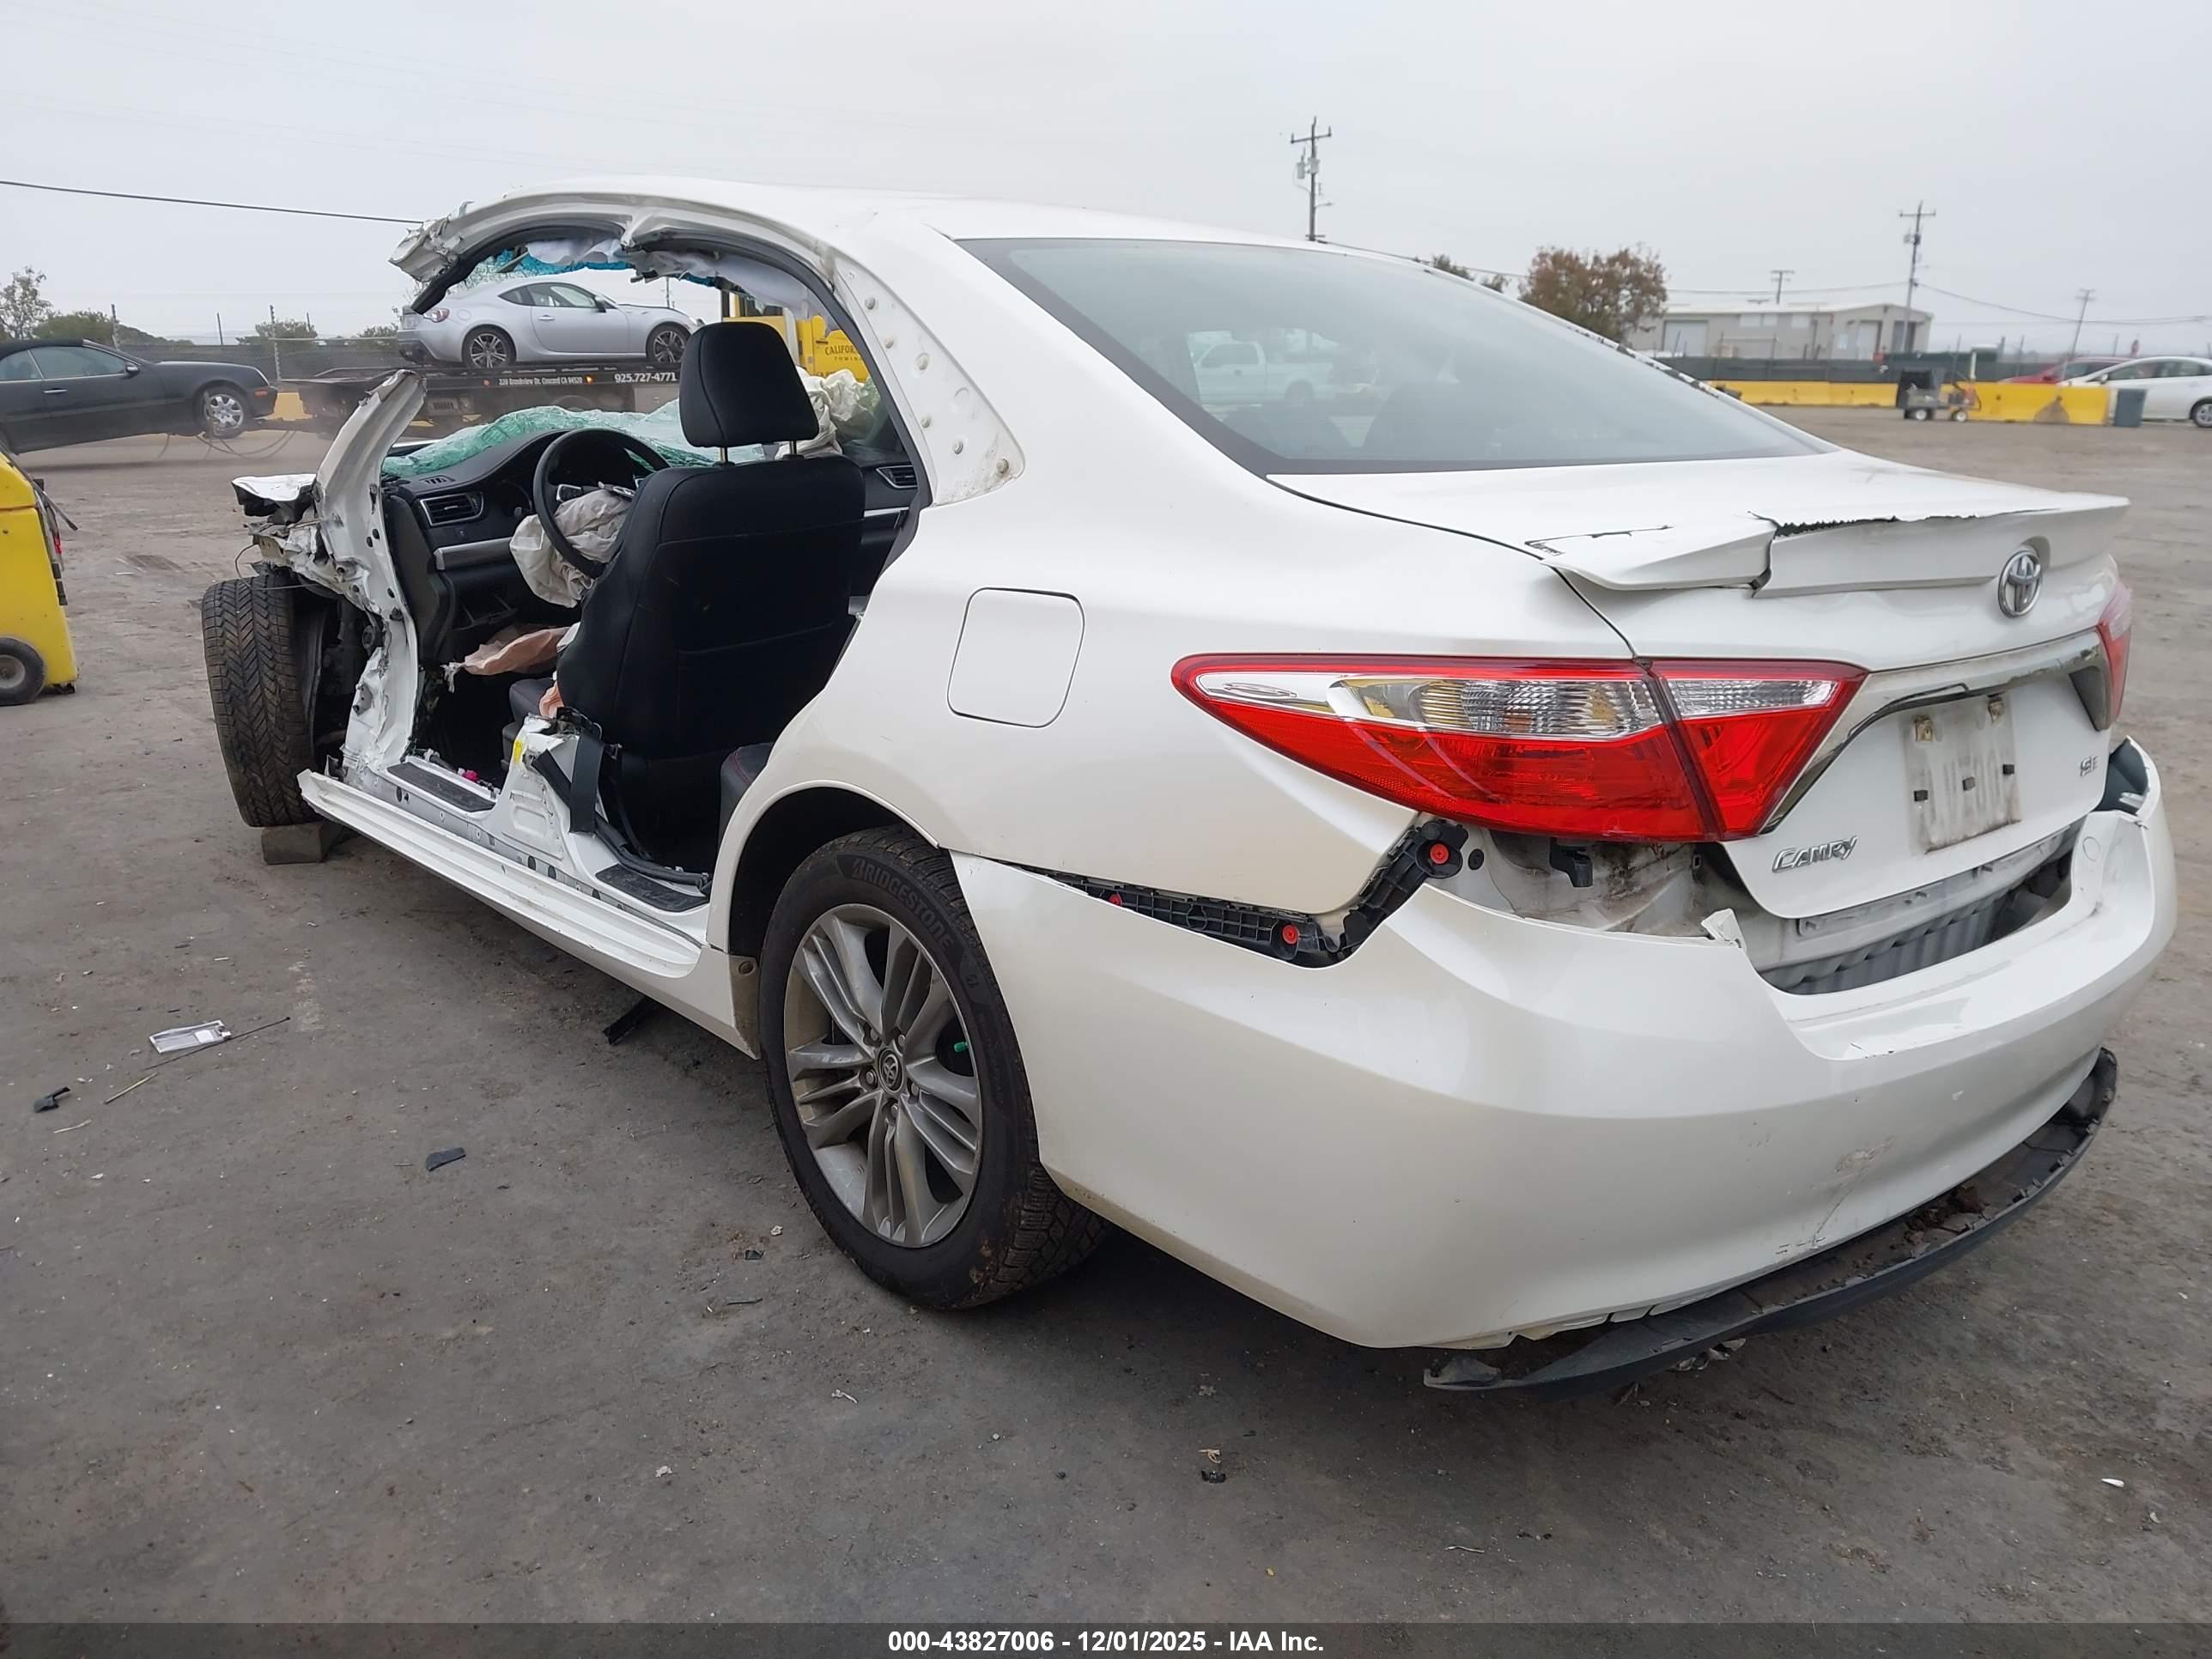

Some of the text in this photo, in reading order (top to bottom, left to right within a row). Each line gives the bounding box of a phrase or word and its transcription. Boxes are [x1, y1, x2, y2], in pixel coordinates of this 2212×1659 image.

[614, 372, 678, 383] 925.727-4771
[1772, 836, 1858, 872] CAMRY
[852, 858, 954, 949] BRIDGESTONE
